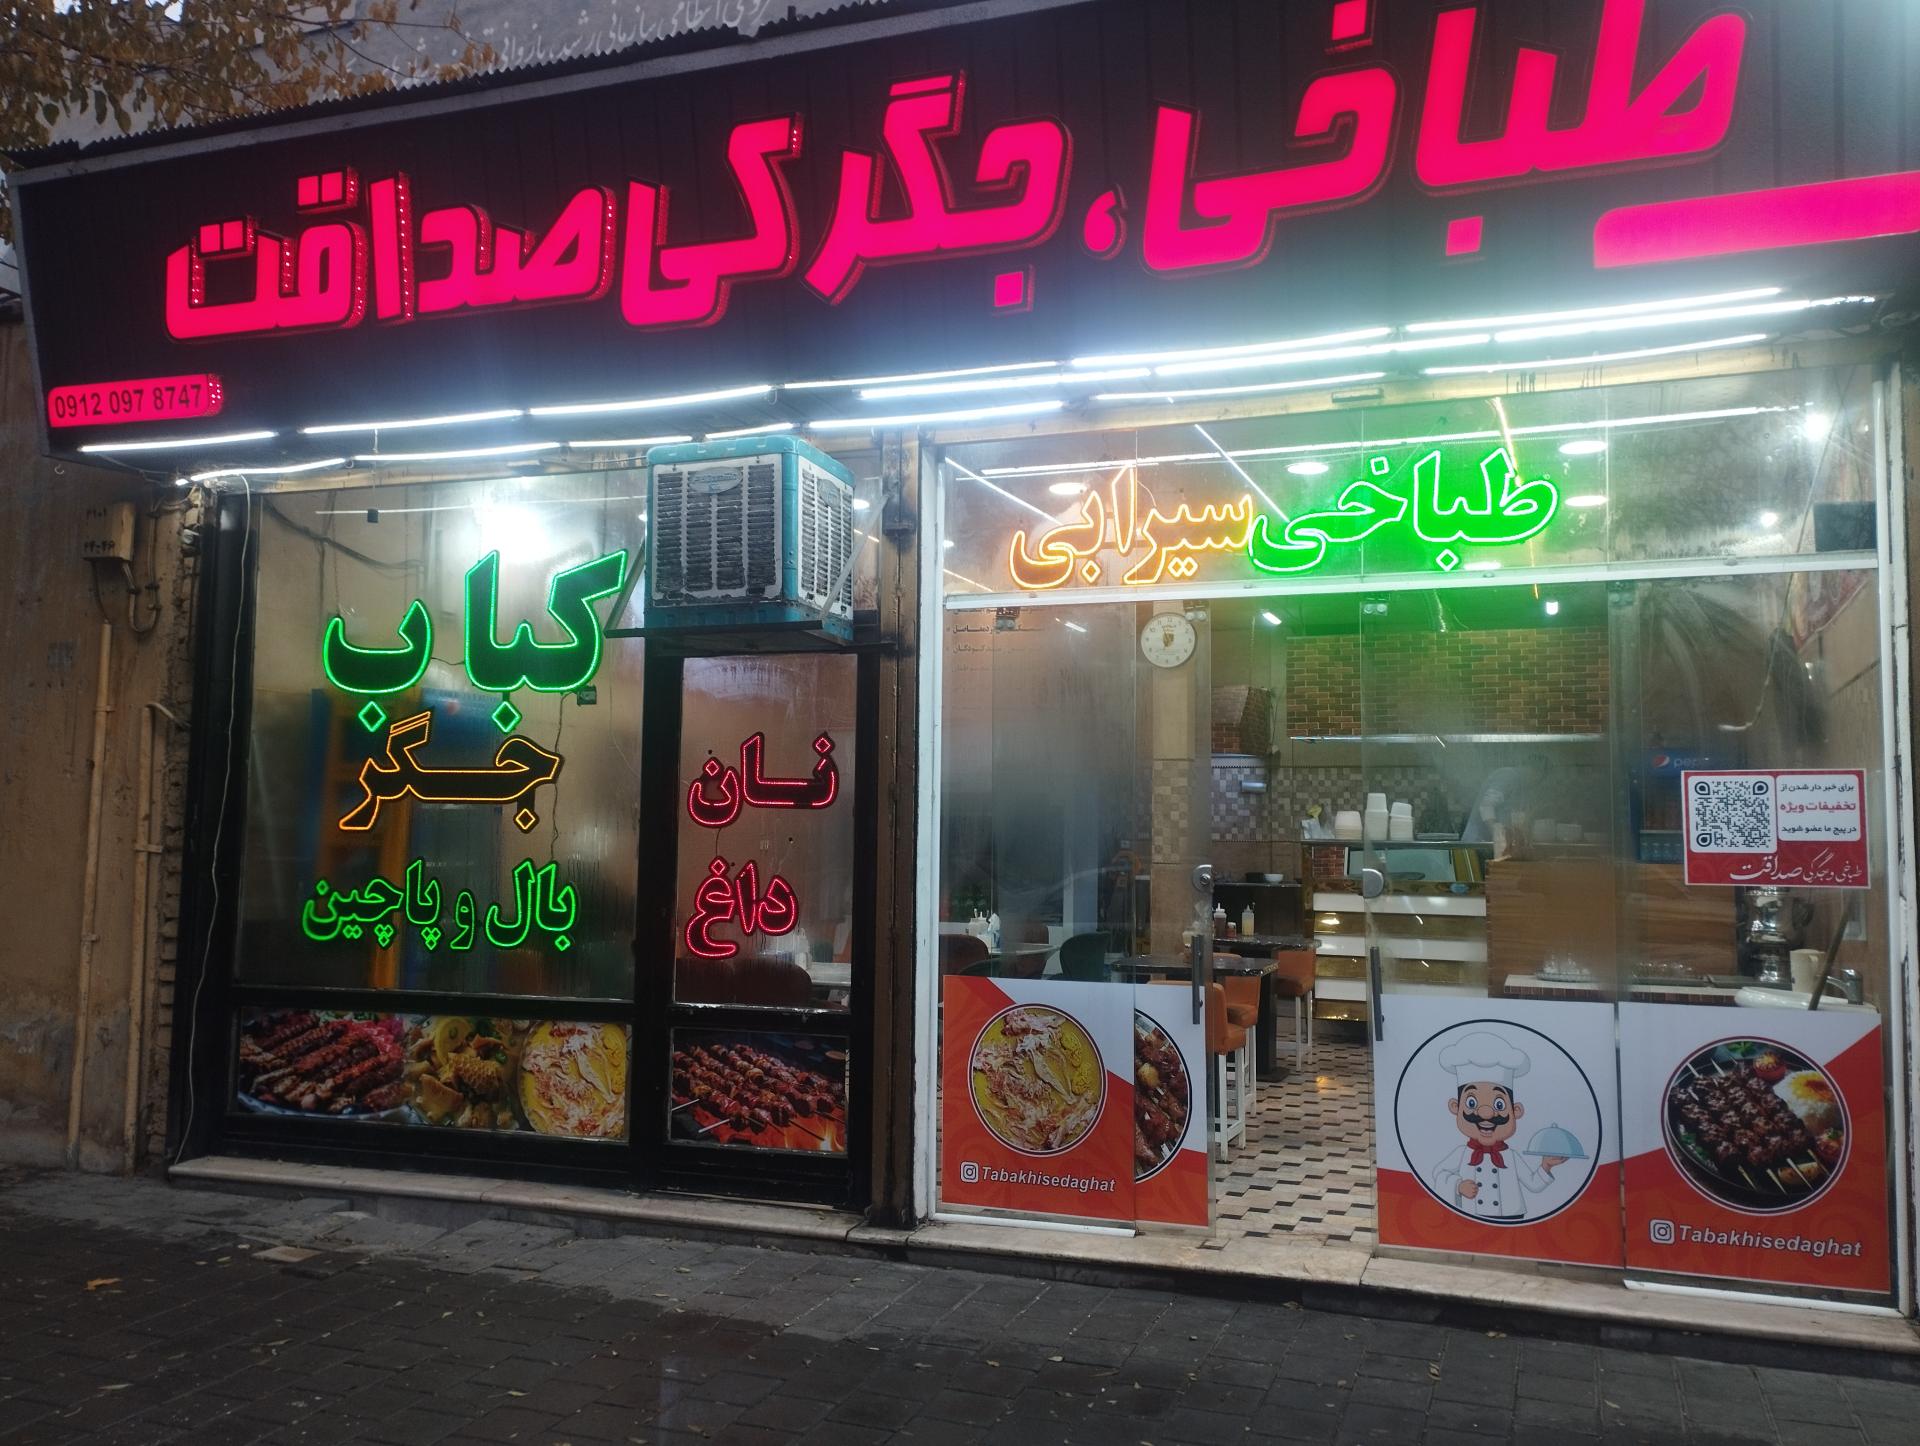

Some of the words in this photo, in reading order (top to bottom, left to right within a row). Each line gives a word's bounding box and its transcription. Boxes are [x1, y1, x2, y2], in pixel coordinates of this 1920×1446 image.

[165, 167, 613, 340] صداقت
[55, 393, 103, 419] 0912
[109, 389, 145, 415] 097
[153, 384, 202, 411] 8747
[1248, 446, 1562, 573] طباخی
[1008, 462, 1255, 591] سیرابی
[322, 548, 629, 734] کباب
[338, 710, 563, 832] جگر
[687, 731, 839, 827] نان
[1780, 783, 1787, 792] از
[1788, 783, 1809, 792] شدن
[1809, 784, 1822, 792] دار
[1822, 783, 1837, 792] خبر
[1838, 783, 1855, 792] برای
[1779, 801, 1805, 814] ویژه
[1806, 801, 1857, 813] تخفیفات
[1781, 825, 1803, 834] شوید
[1804, 825, 1822, 834] عضو
[1846, 826, 1857, 834] در
[1729, 855, 1803, 881] صداقت
[1826, 870, 1835, 881] و
[1835, 860, 1862, 883] طباخی
[302, 859, 442, 951] پاچین
[484, 858, 579, 952] بال
[685, 856, 798, 959] داغ
[450, 890, 477, 951] و
[981, 1165, 1116, 1194] Tabakhisedaghat
[1679, 1224, 1863, 1258] Tabakhisedaghat
